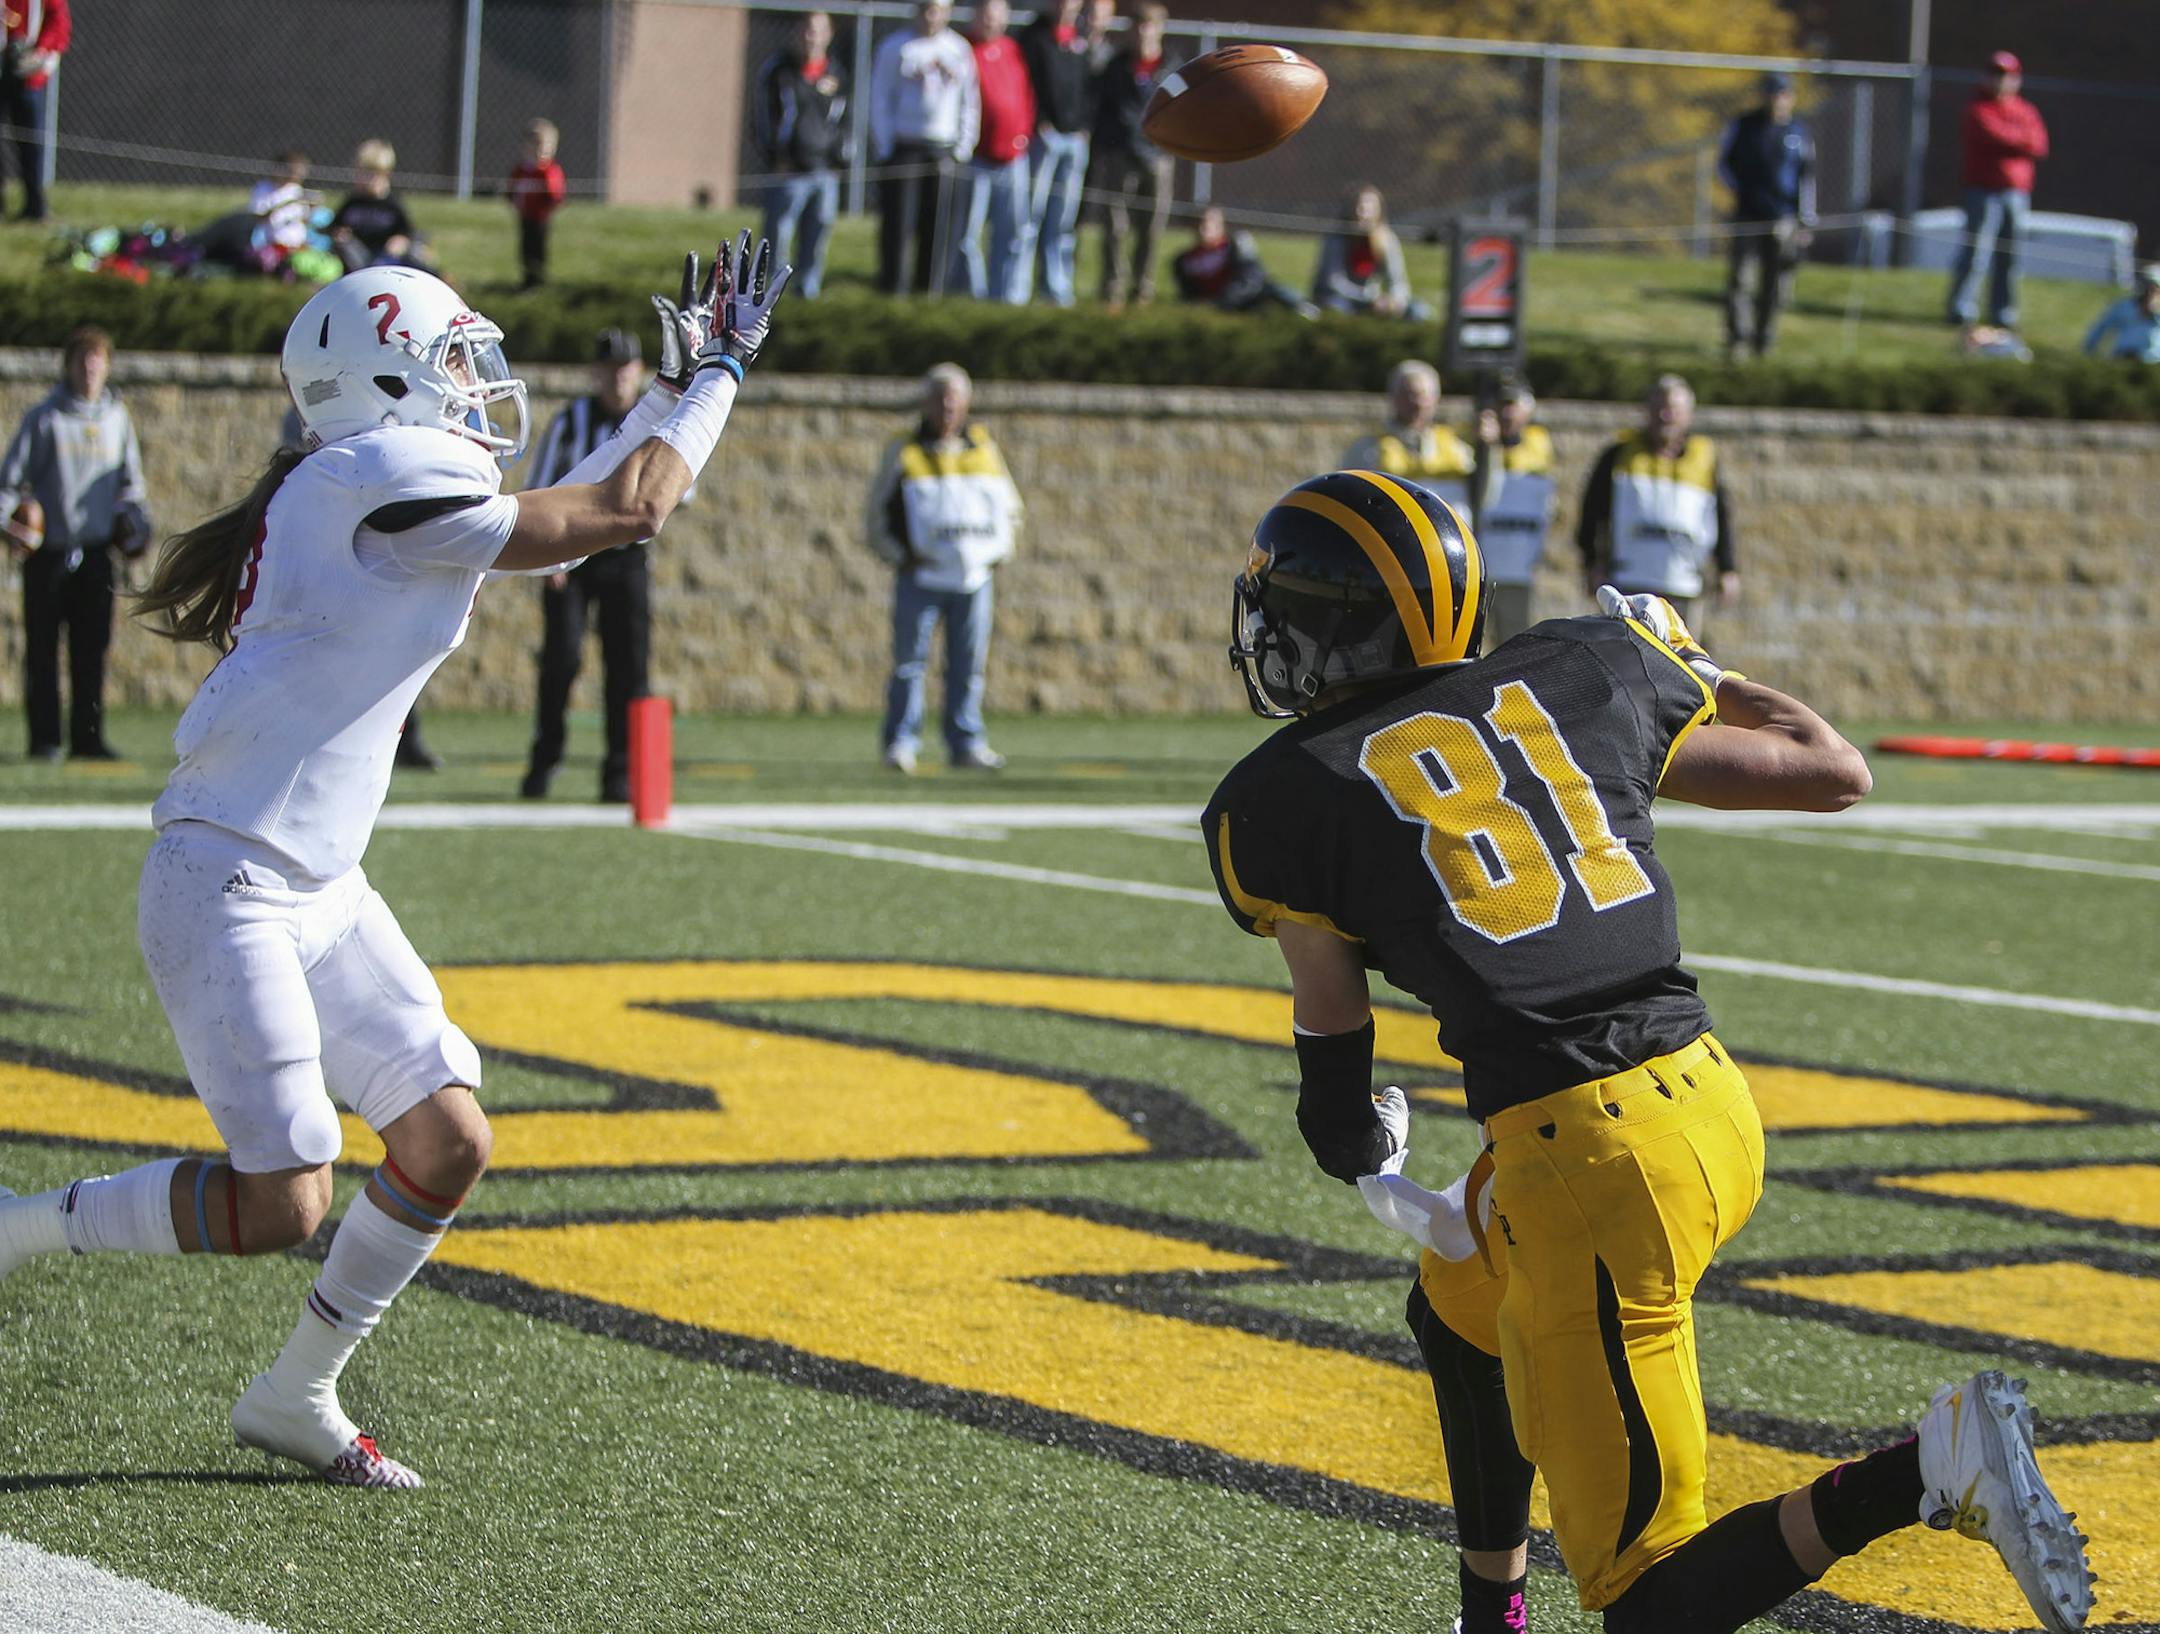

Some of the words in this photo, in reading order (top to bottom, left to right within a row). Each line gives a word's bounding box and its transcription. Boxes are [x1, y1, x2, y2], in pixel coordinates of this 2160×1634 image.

[1461, 236, 1518, 313] 2
[368, 293, 411, 345] 2
[1358, 680, 1656, 944] 81
